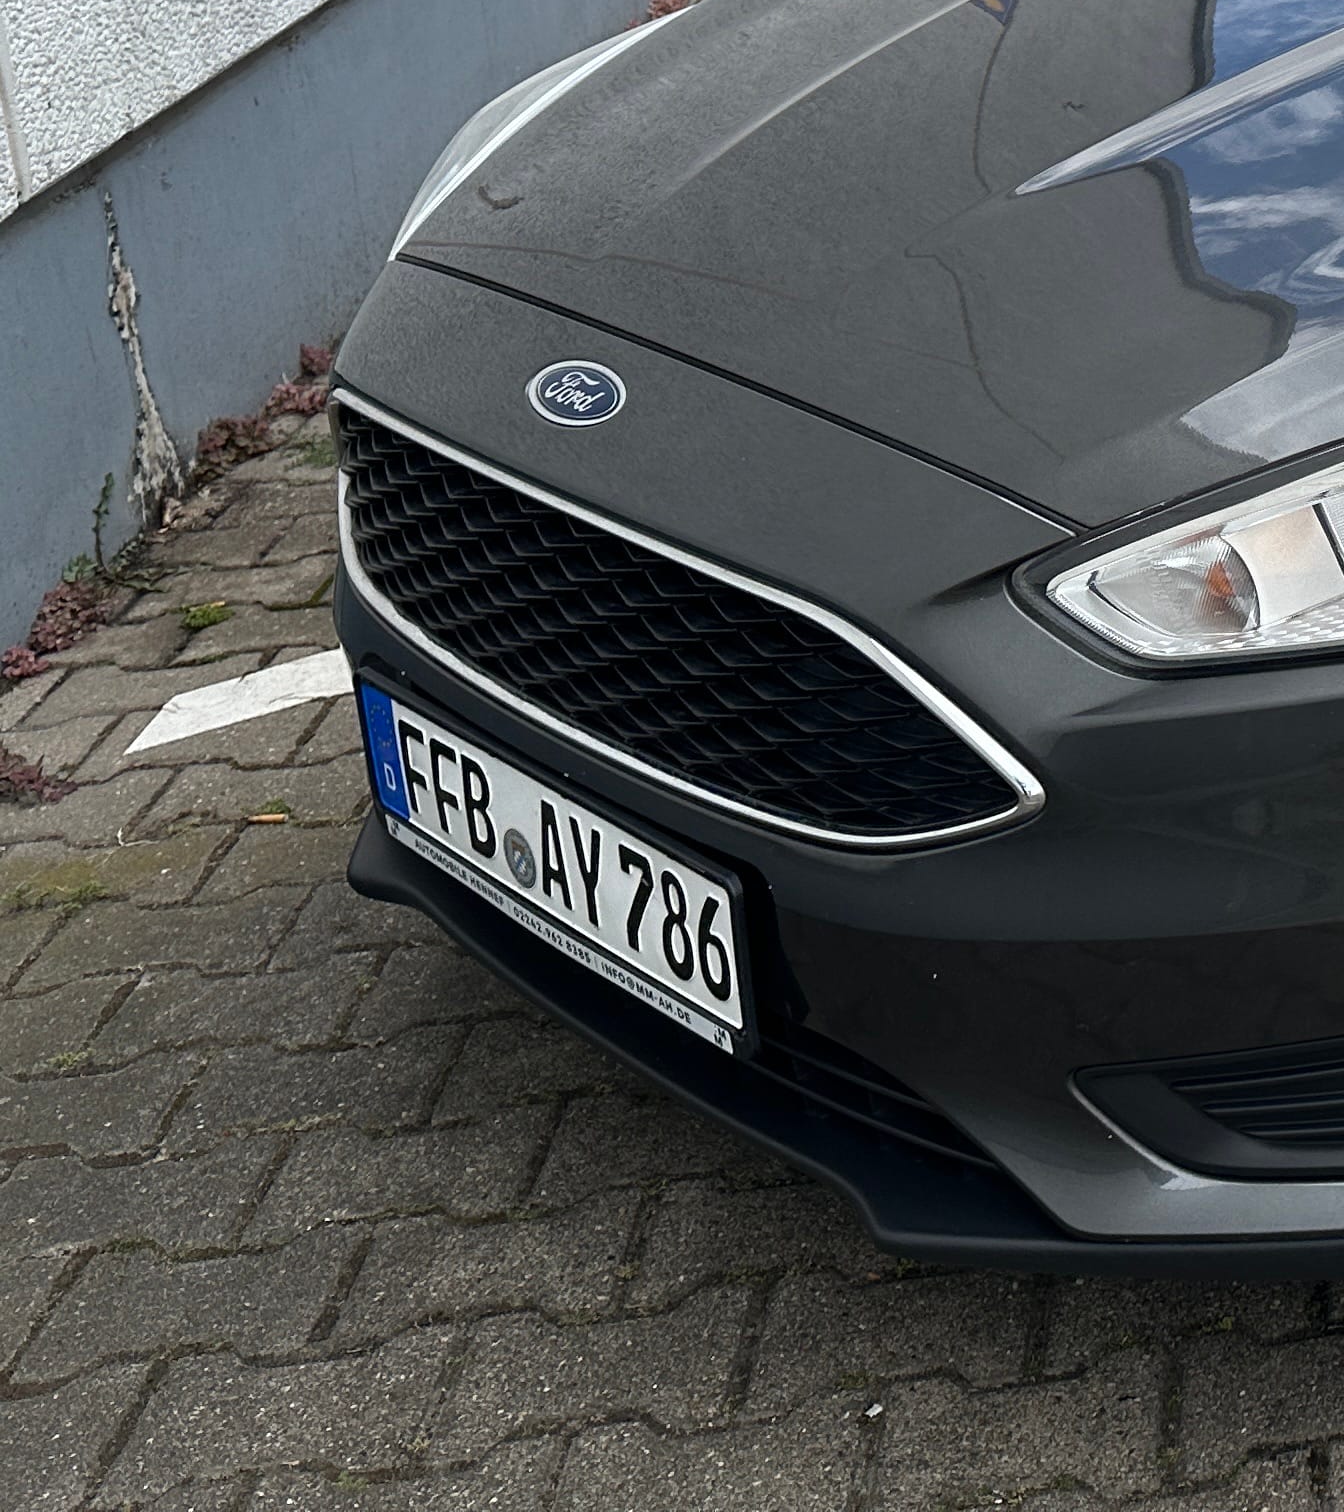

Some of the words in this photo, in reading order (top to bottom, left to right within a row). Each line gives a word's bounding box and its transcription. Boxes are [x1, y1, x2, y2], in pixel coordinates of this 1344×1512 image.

[544, 371, 606, 412] Ford
[384, 762, 397, 791] D
[398, 718, 497, 860] FFB
[541, 799, 601, 929] AY
[618, 843, 731, 1002] 786
[415, 838, 469, 882] AUTOMOBILE
